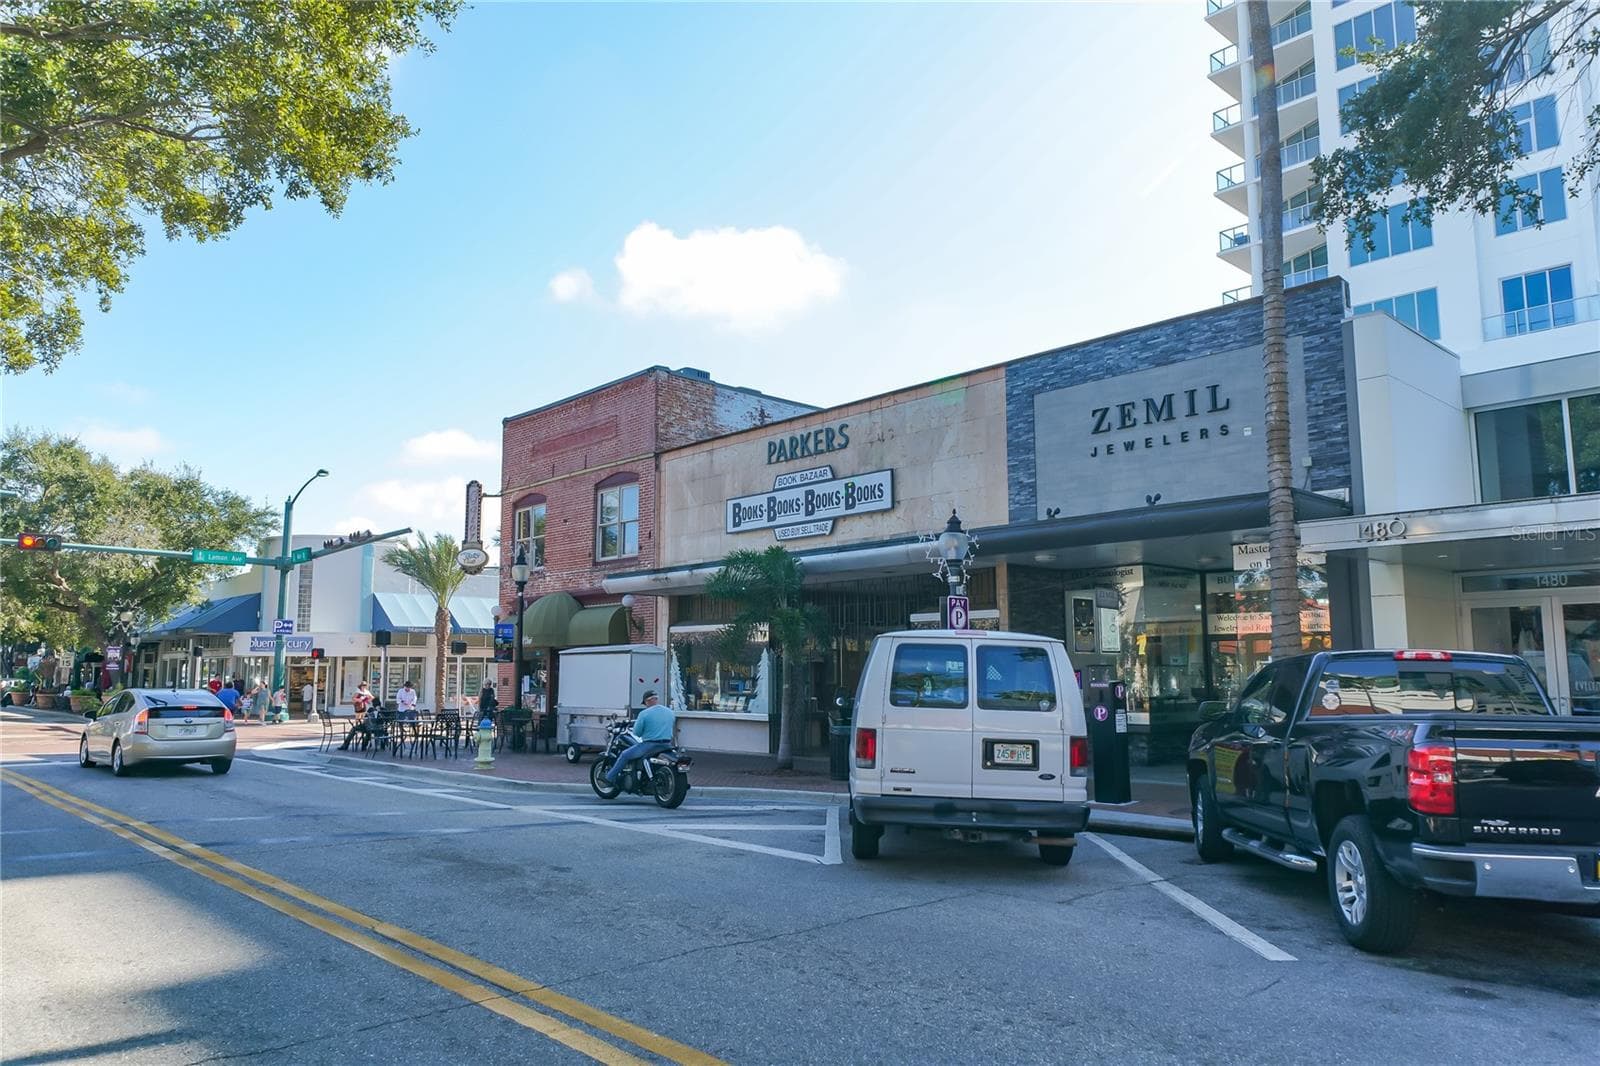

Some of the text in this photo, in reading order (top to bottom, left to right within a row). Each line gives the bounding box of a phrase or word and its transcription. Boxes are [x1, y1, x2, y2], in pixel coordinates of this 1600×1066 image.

[1090, 384, 1230, 435] ZEMIL
[767, 423, 850, 465] PARKERS
[1090, 424, 1230, 458] JEWELERS
[777, 469, 828, 487] BOOK BAZAAR
[1356, 520, 1407, 540] 1480
[207, 553, 228, 561] Lemon
[1238, 545, 1270, 555] Maste
[1535, 573, 1569, 587] 1480
[951, 599, 966, 608] PAY
[249, 637, 312, 651] bluemcury
[1472, 825, 1562, 836] SILVERADO
